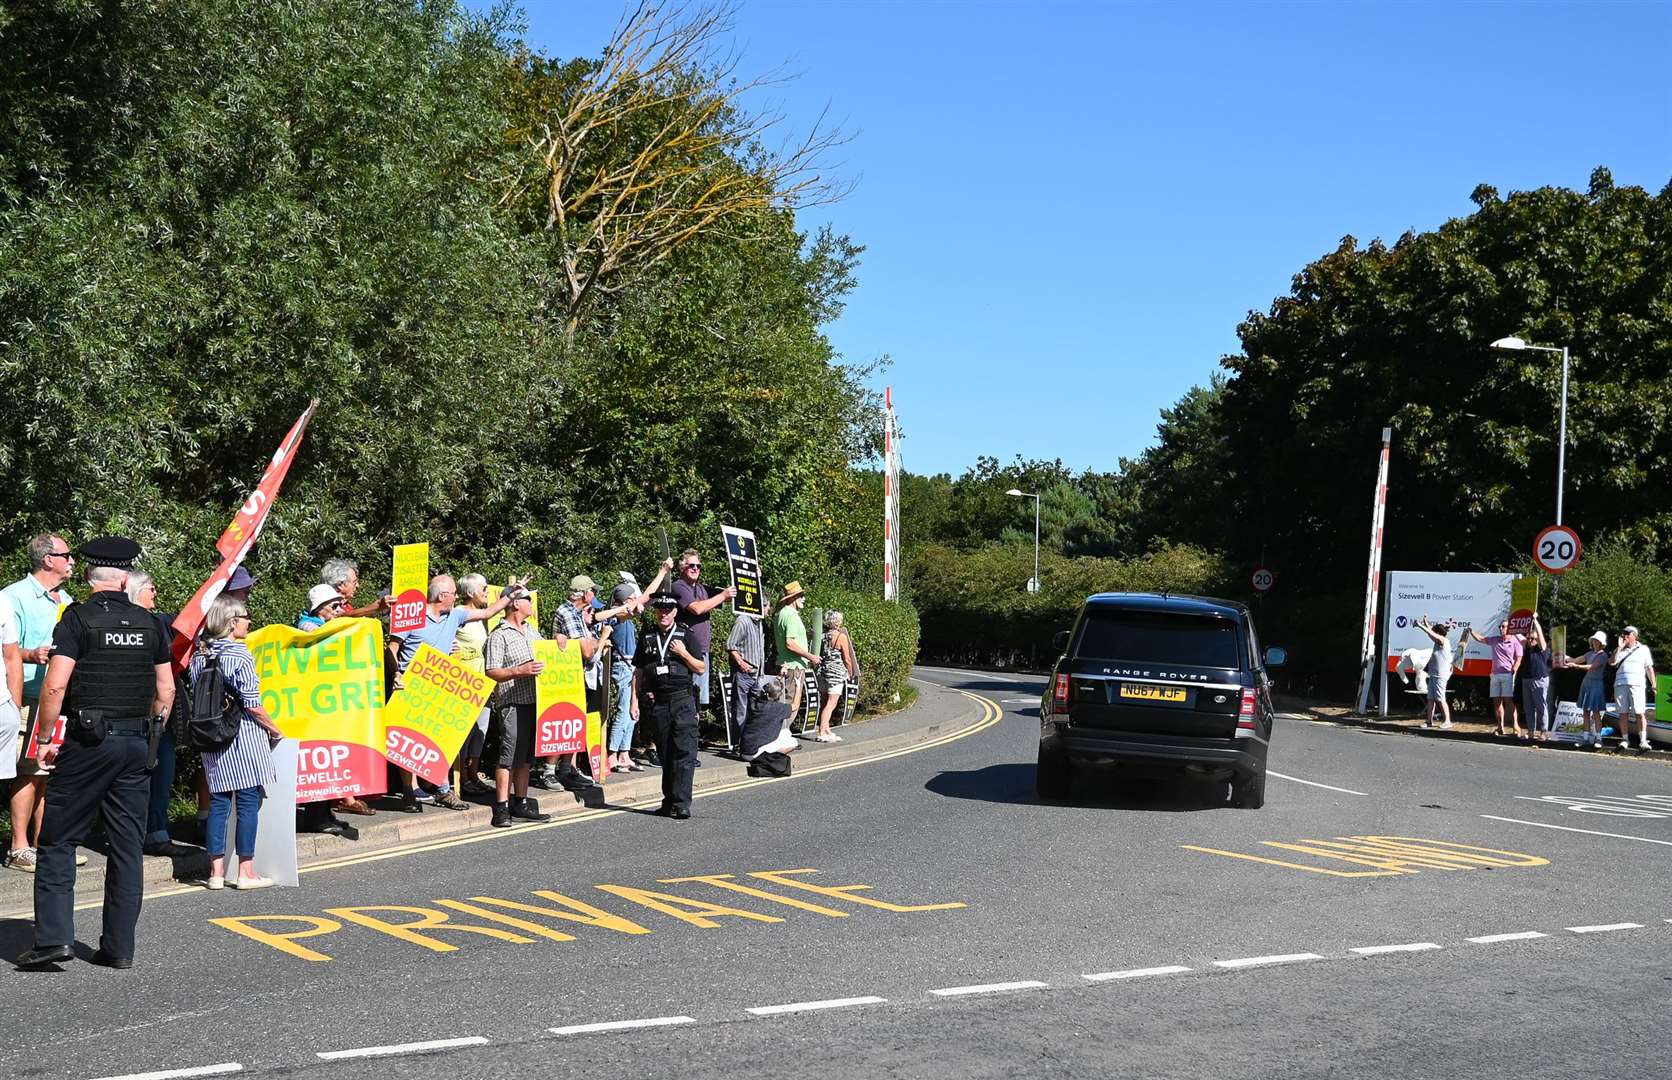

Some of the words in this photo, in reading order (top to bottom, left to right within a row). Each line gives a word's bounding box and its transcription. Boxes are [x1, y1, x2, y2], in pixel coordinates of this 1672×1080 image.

[1541, 541, 1573, 560] 20
[1255, 574, 1272, 586] 20
[1452, 593, 1474, 601] Station
[395, 601, 424, 619] STOP
[1509, 616, 1532, 629] STOP
[105, 633, 144, 646] POLICE
[536, 649, 581, 665] CHAOS
[425, 651, 485, 691] WRONG
[539, 668, 582, 686] COAST
[1104, 668, 1150, 677] RANGE
[1160, 672, 1208, 680] ROVER
[410, 662, 485, 708] DECISION
[1126, 684, 1156, 697] NU67
[1159, 686, 1181, 699] WJF
[261, 687, 299, 721] OT
[409, 678, 442, 701] BUT
[441, 695, 472, 717] IT'S
[399, 690, 431, 713] NOT
[436, 706, 469, 732] TOO
[542, 718, 583, 742] STOP
[387, 729, 440, 765] STOP
[540, 742, 576, 754] SIZEWELL
[299, 744, 350, 771] TOP
[424, 768, 431, 777] C
[207, 867, 967, 961] PRIVATE
